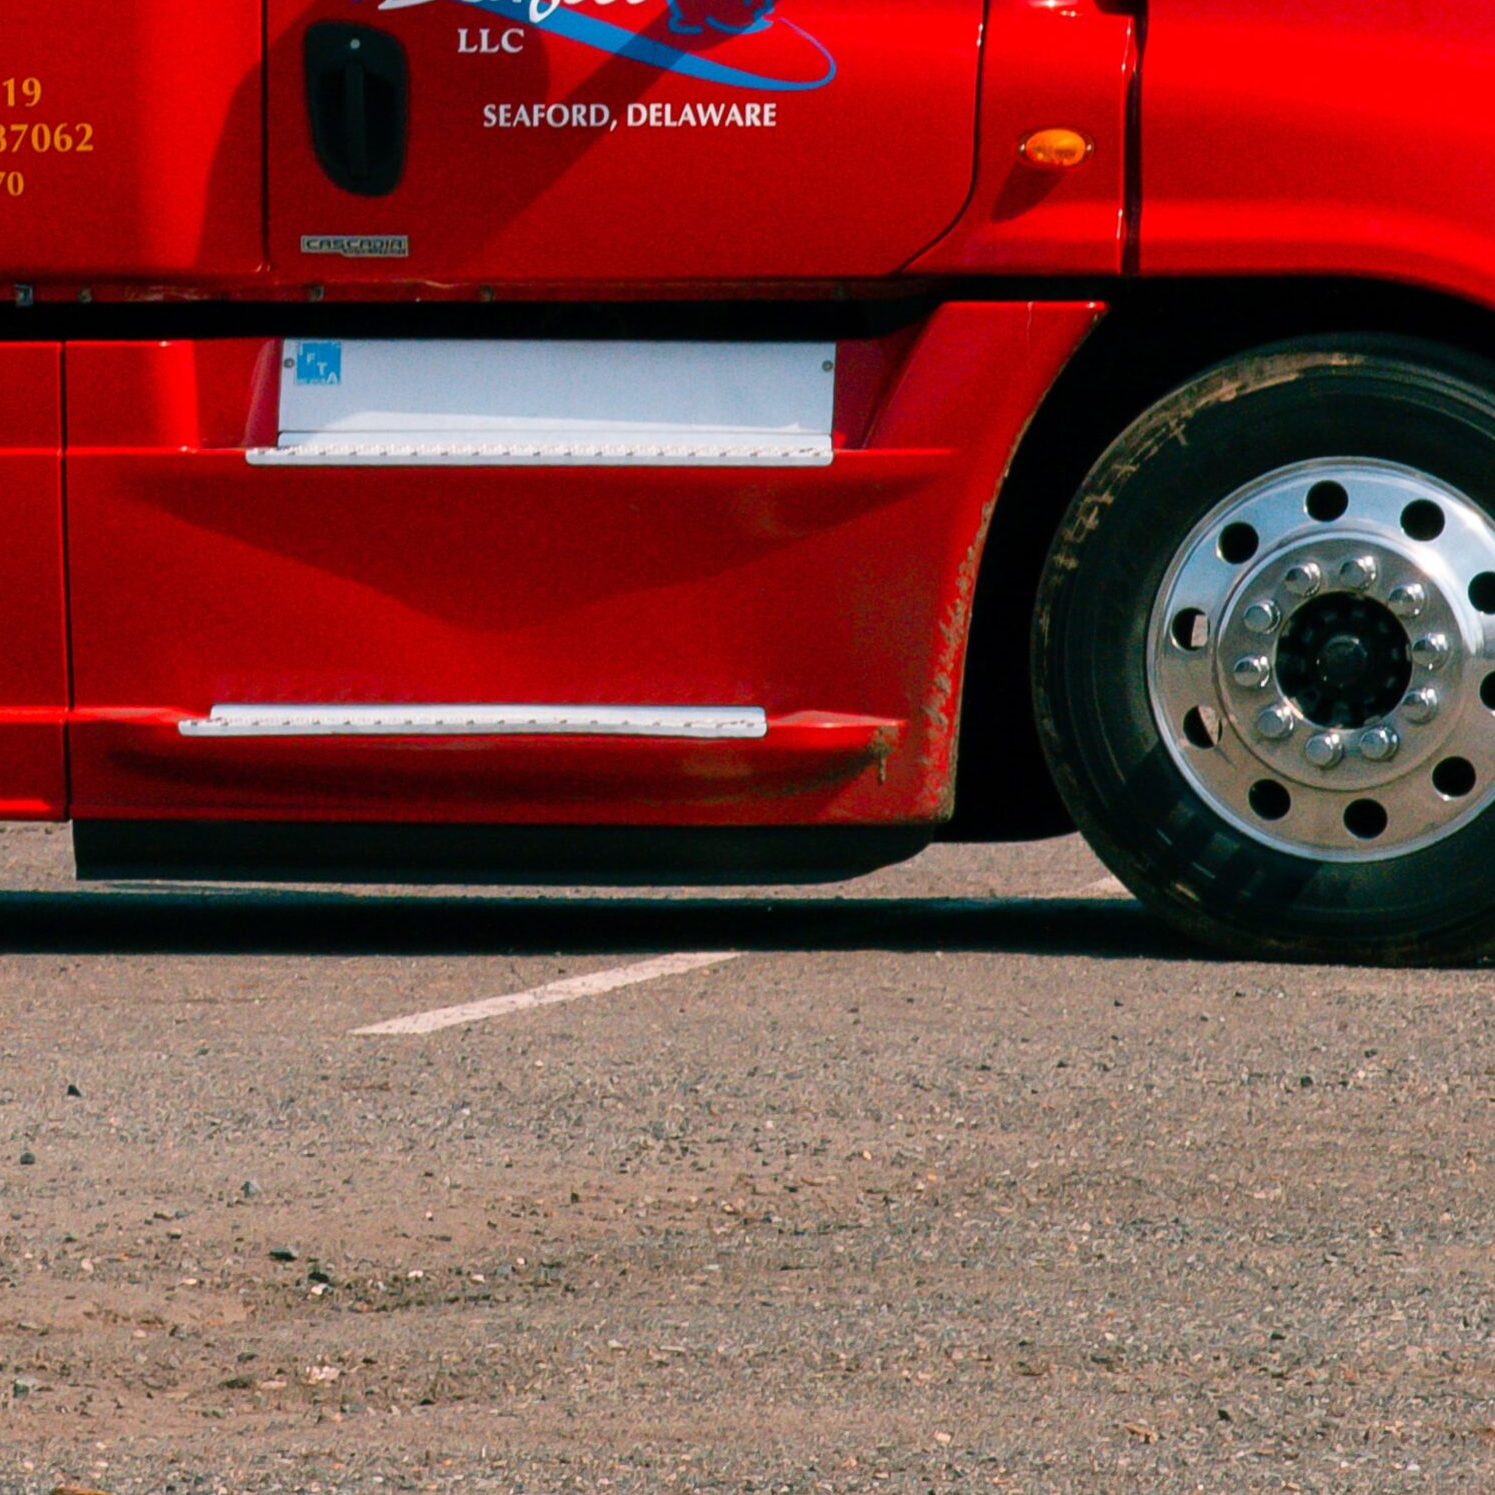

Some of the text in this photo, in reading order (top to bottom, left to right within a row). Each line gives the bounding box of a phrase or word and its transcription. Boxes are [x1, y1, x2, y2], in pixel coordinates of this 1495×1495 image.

[458, 29, 524, 53] LLC
[483, 103, 776, 132] SEAFORD, DELAWARE
